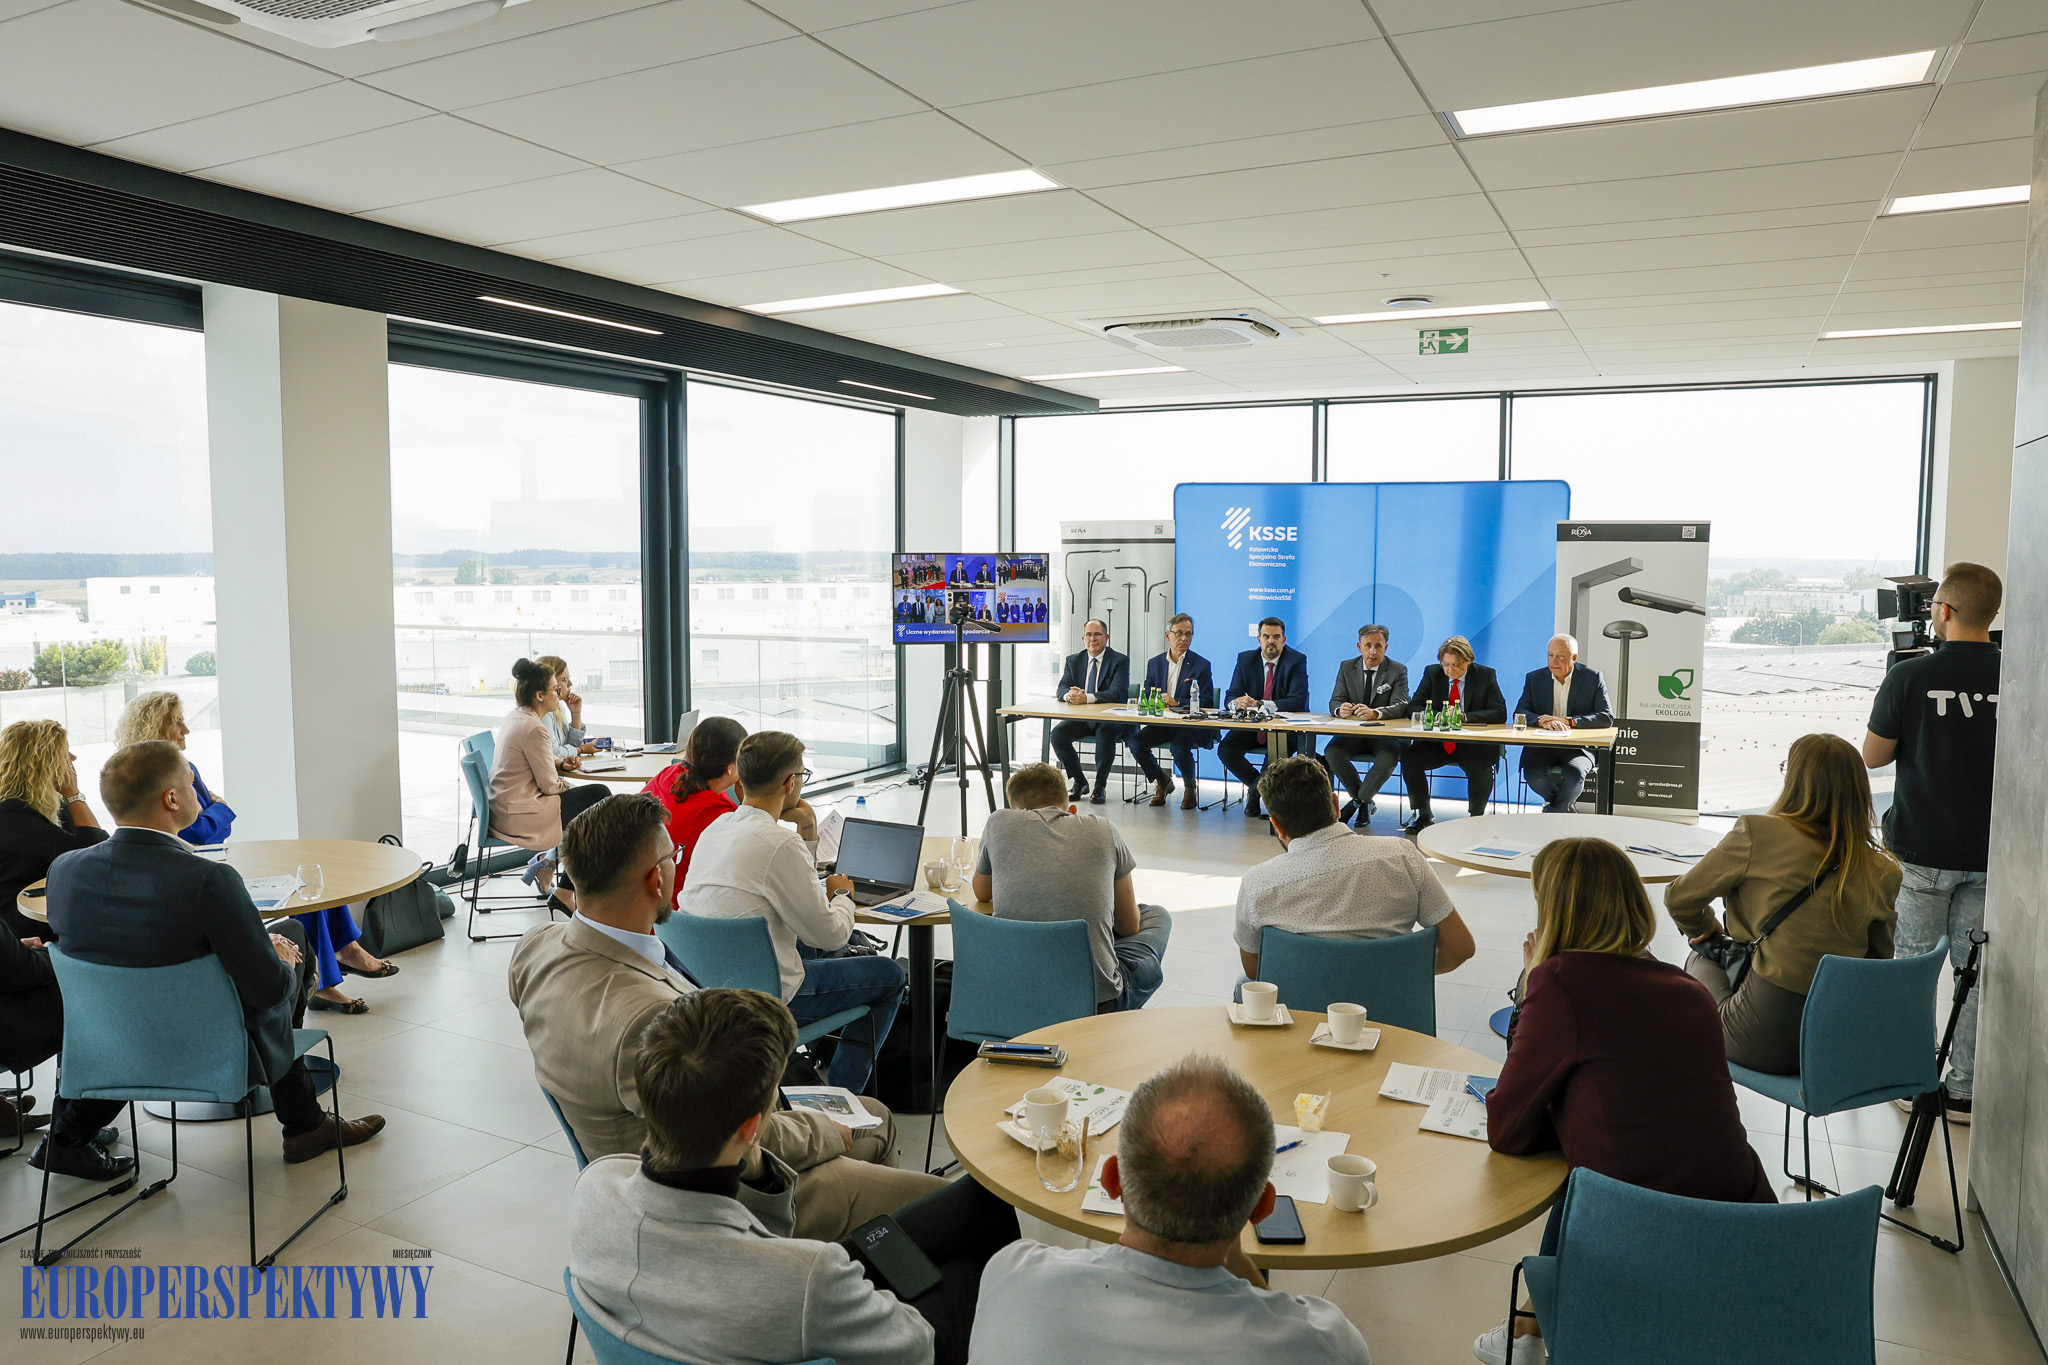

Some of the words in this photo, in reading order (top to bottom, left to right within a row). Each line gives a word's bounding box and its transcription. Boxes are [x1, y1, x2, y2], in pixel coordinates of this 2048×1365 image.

[1249, 526, 1298, 541] KSSE
[1571, 527, 1592, 537] ROSA
[1655, 709, 1692, 717] EKOLOGIA
[866, 1227, 889, 1243] 17:34
